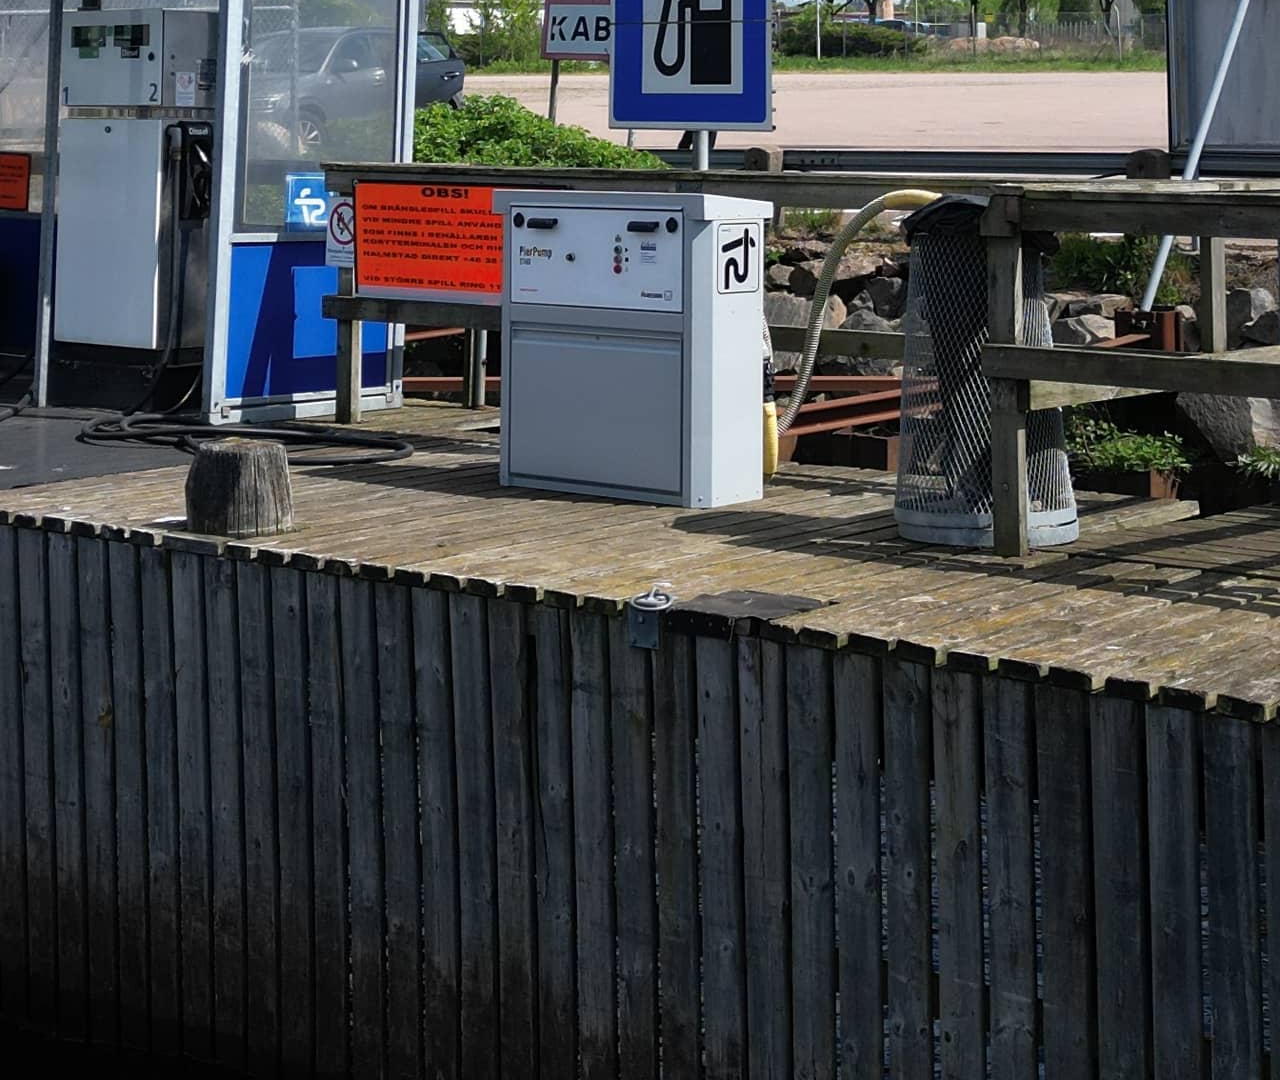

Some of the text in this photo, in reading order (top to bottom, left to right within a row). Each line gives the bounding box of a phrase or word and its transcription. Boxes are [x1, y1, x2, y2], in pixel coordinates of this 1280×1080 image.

[550, 15, 611, 42] KAB
[62, 86, 69, 105] 1
[149, 82, 158, 102] 2
[421, 187, 469, 199] OBS!
[382, 217, 421, 226] MINDRE
[425, 219, 453, 227] SPILL
[363, 228, 385, 236] SOM
[387, 230, 418, 238] FINNS
[427, 231, 498, 241] BEHÅLLAREN
[363, 238, 503, 252] KORTTERMINALEN OCH RIN
[363, 250, 418, 260] HALMSTAD
[421, 253, 460, 262] DIREKT
[363, 274, 381, 282] VID
[383, 276, 425, 285] STÖRRE
[427, 279, 457, 287] SPILL
